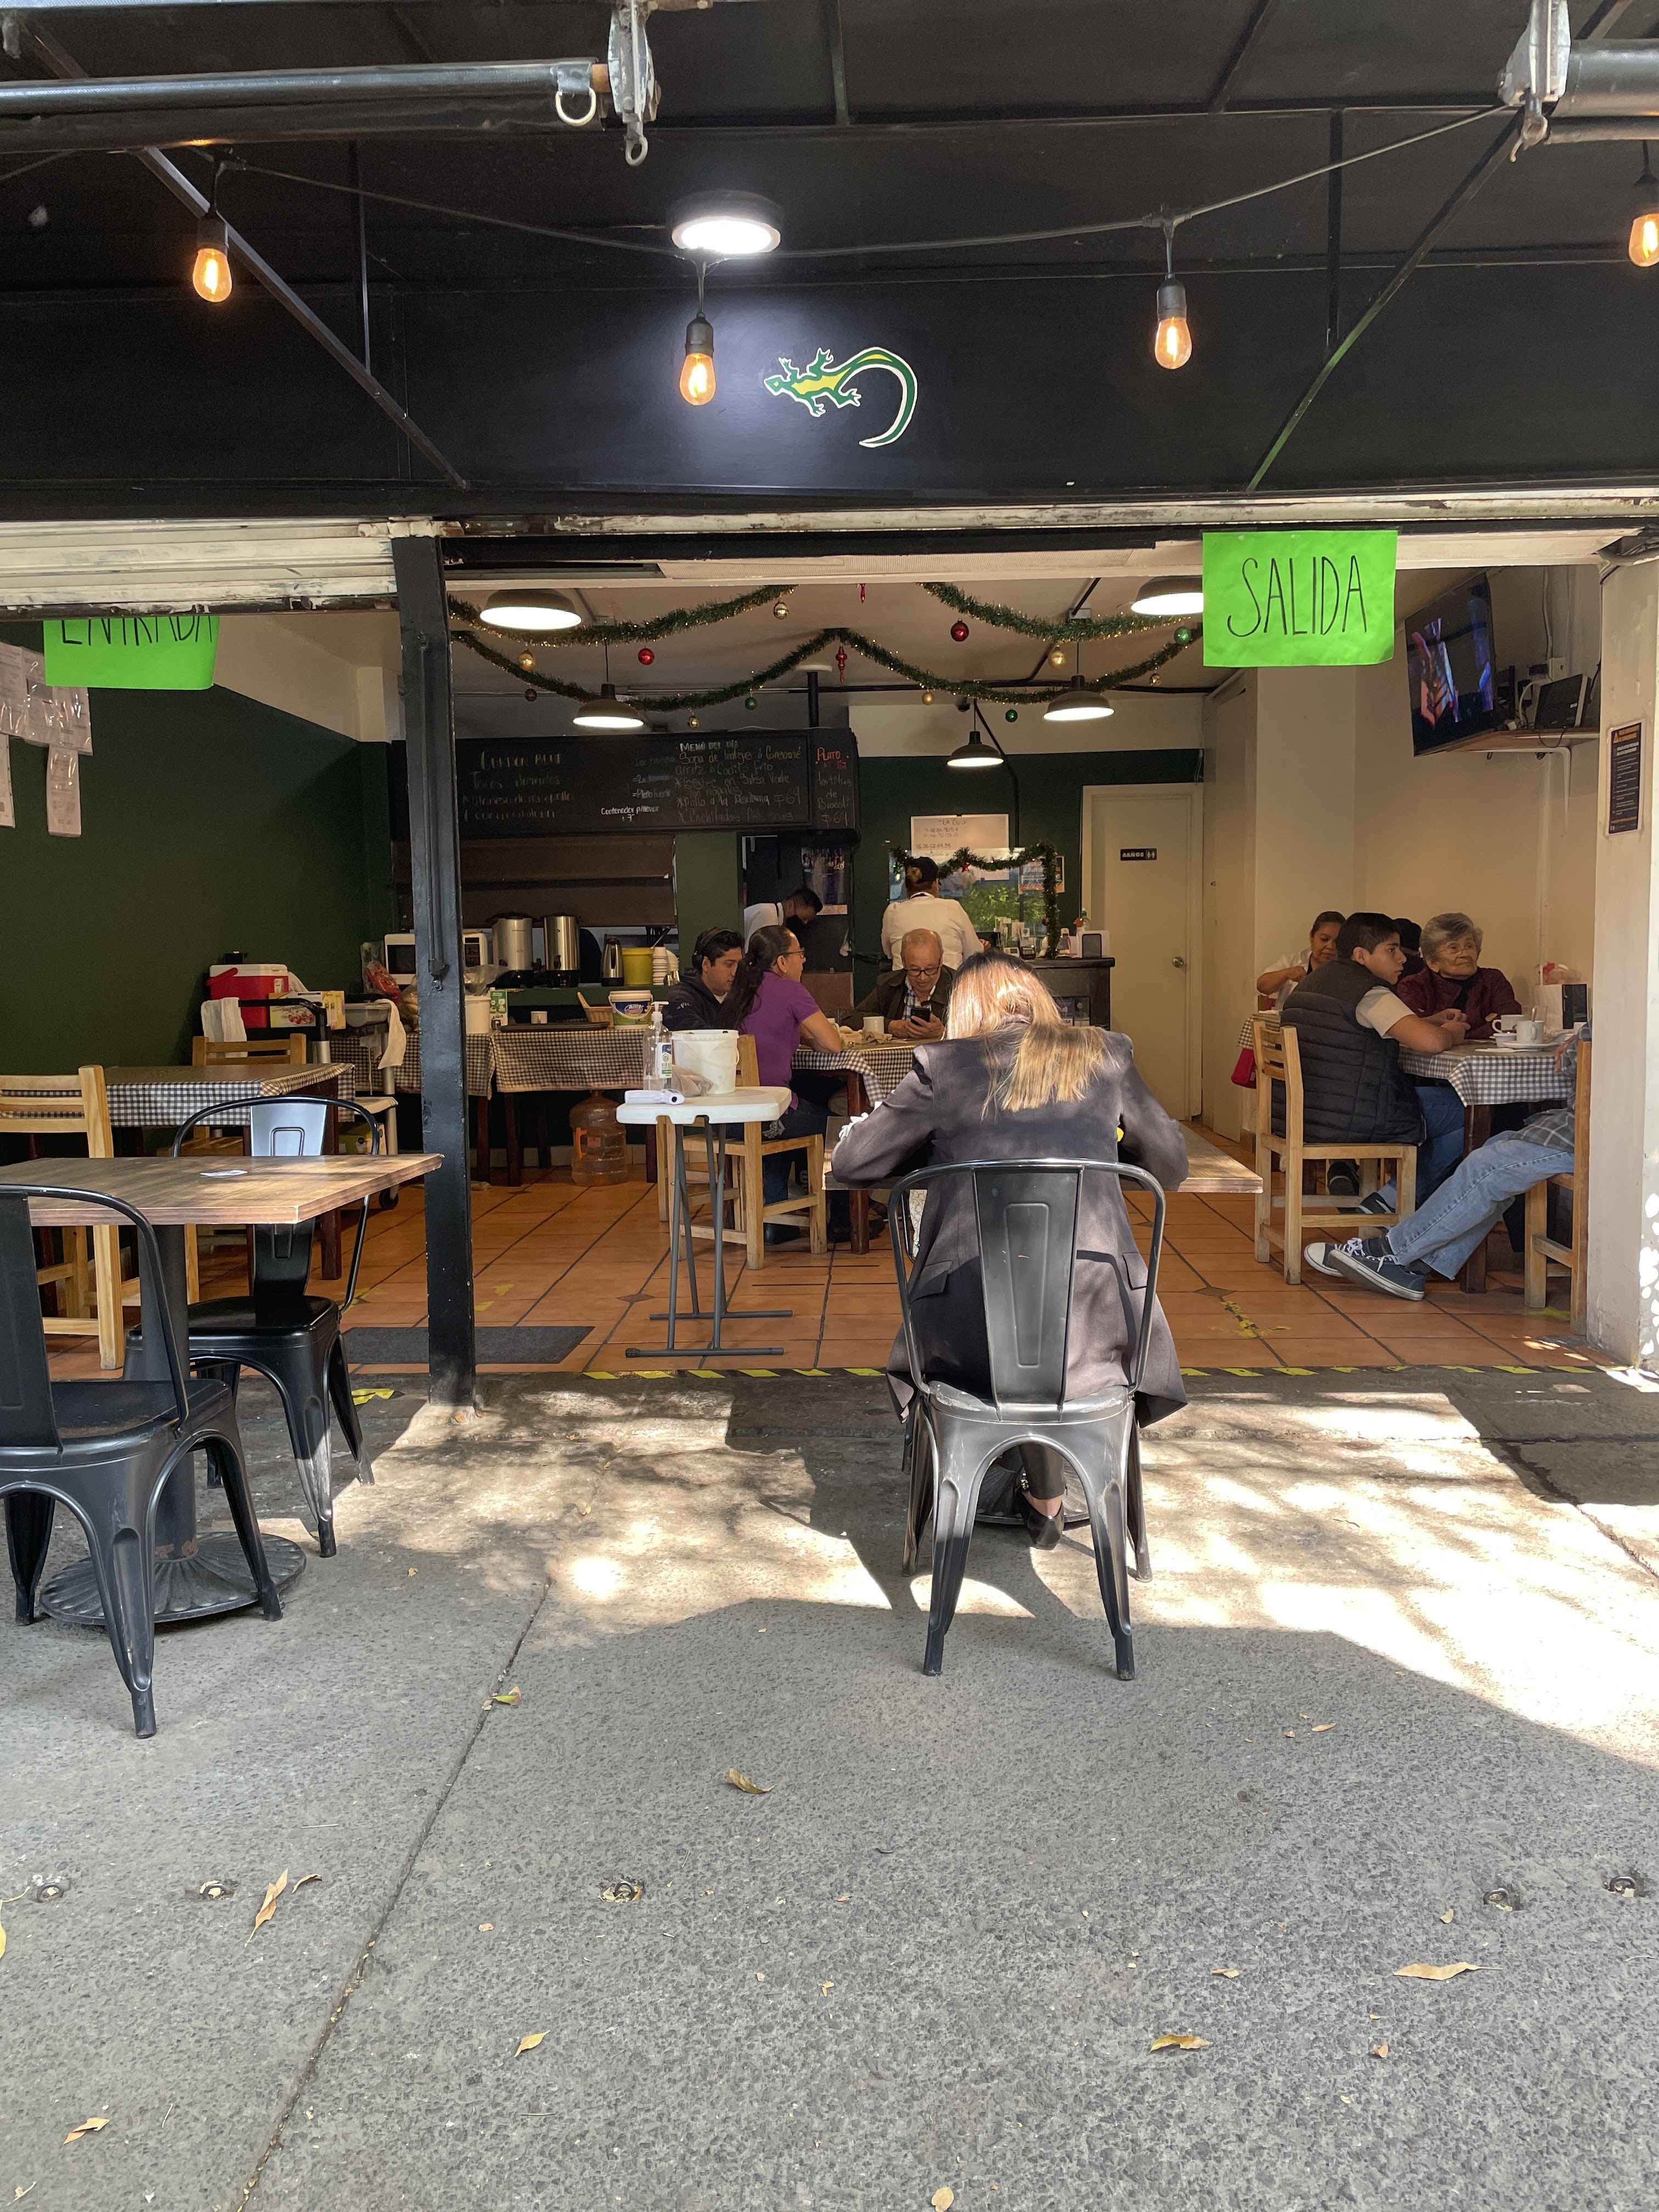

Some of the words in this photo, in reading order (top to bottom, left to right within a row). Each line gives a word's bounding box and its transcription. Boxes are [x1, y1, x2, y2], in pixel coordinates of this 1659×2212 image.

[1227, 555, 1367, 637] SALIDA
[708, 752, 719, 763] de
[817, 747, 841, 761] PLATO
[826, 789, 838, 799] de
[601, 806, 635, 816] Contenedor
